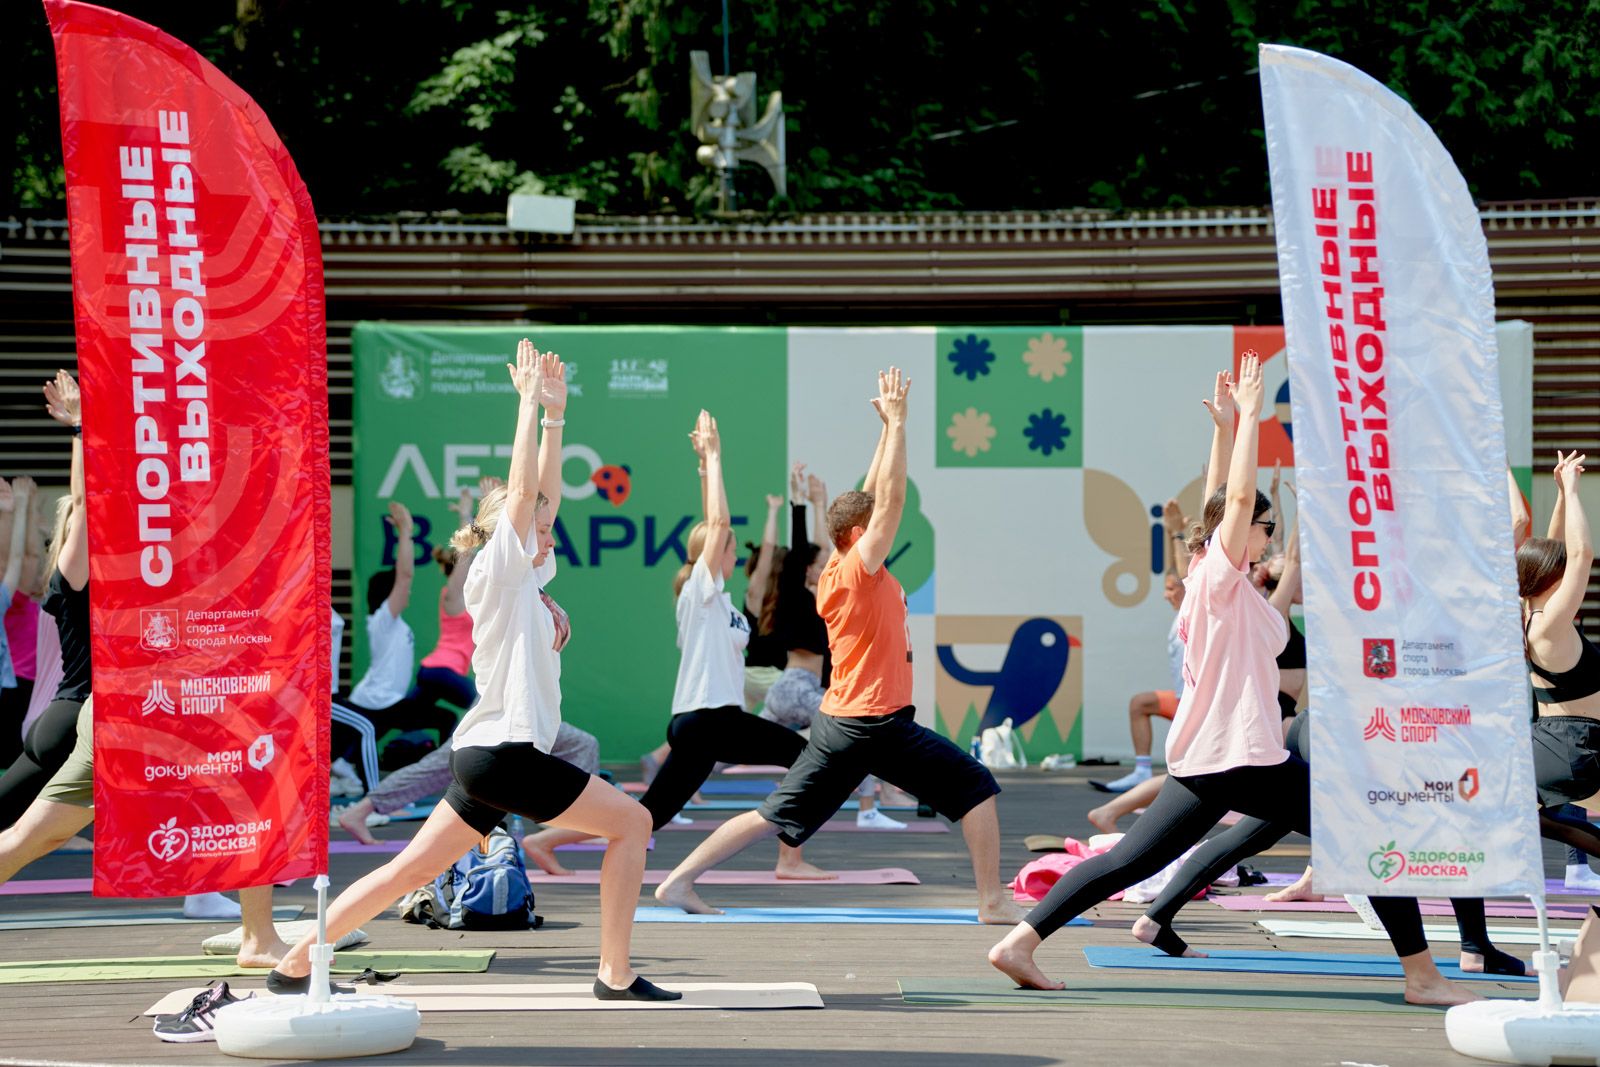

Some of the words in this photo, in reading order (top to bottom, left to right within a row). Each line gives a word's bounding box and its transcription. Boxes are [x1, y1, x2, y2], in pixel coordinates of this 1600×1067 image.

[158, 110, 210, 482] ВЫХОДНЫЕ
[1346, 152, 1395, 511] ВЫХОДНЫЕ
[119, 146, 173, 588] СПОРТИВНЫЕ
[1312, 188, 1381, 611] СПОРТИВНЫЕ
[377, 444, 605, 500] ЛЕО
[186, 609, 260, 621] Департамент
[186, 624, 225, 634] спорта
[187, 637, 226, 647] города
[229, 634, 272, 645] Москвы
[1402, 640, 1455, 651] Департамент
[1403, 654, 1428, 663] спорта
[1404, 667, 1430, 677] города
[1432, 667, 1467, 676] Москвы
[180, 671, 271, 697] МОСКОВСКИЙ
[181, 696, 227, 715] СПОРТ
[1400, 705, 1471, 725] МОСКОВСКИЙ
[1401, 726, 1437, 742] СПОРТ
[144, 762, 243, 781] документы
[1367, 790, 1454, 805] документы
[191, 819, 272, 839] ЗДОРОВАЯ
[192, 836, 257, 852] МОСКВА
[1408, 851, 1485, 863] ЗДОРОВАЯ
[1407, 865, 1468, 876] МОСКВА
